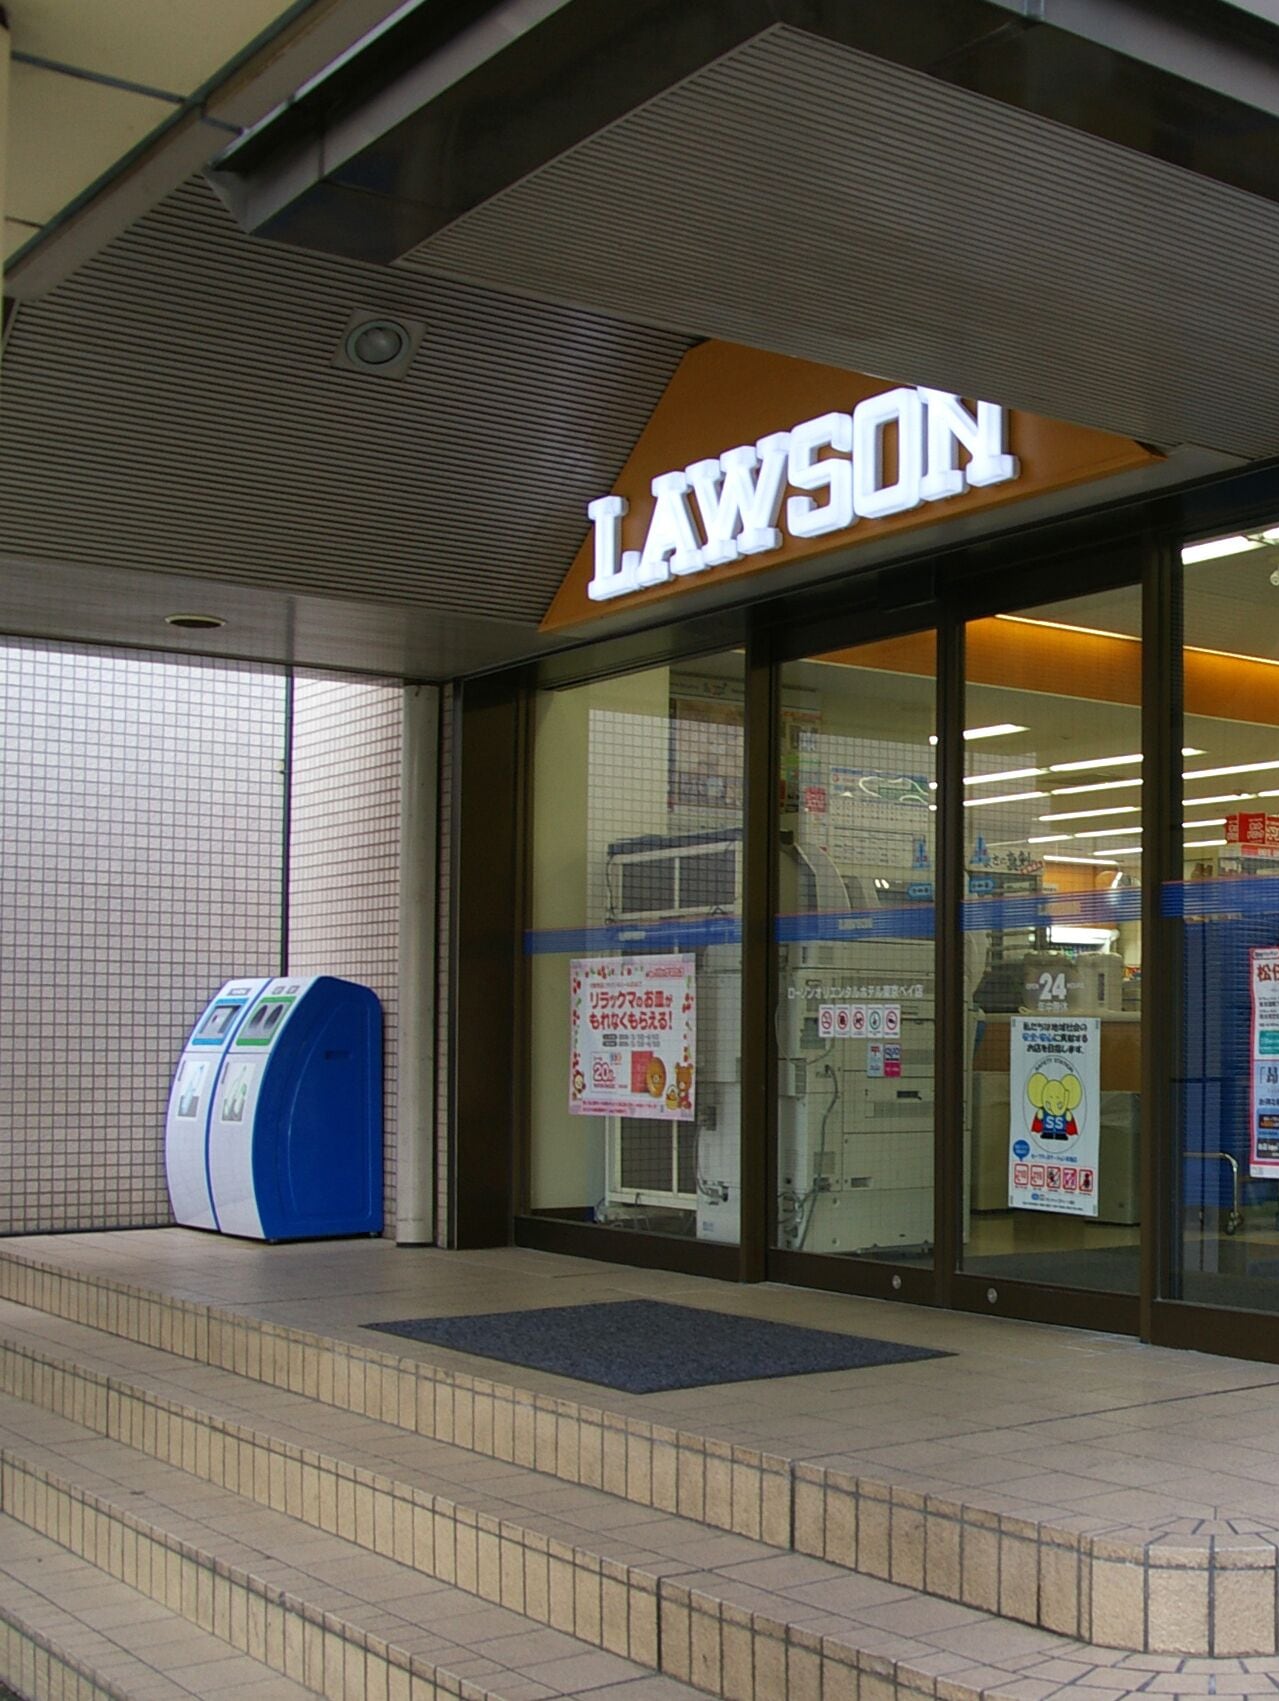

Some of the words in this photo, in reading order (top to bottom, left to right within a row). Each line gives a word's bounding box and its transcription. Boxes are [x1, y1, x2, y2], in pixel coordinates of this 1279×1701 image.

[587, 386, 1021, 601] LAWSON
[787, 983, 924, 999] ローソンオリエンタルホテル東京ベイ店
[1039, 972, 1067, 1000] 24
[589, 990, 673, 1010] リラックマのお皿が
[1045, 1115, 1065, 1130] SS
